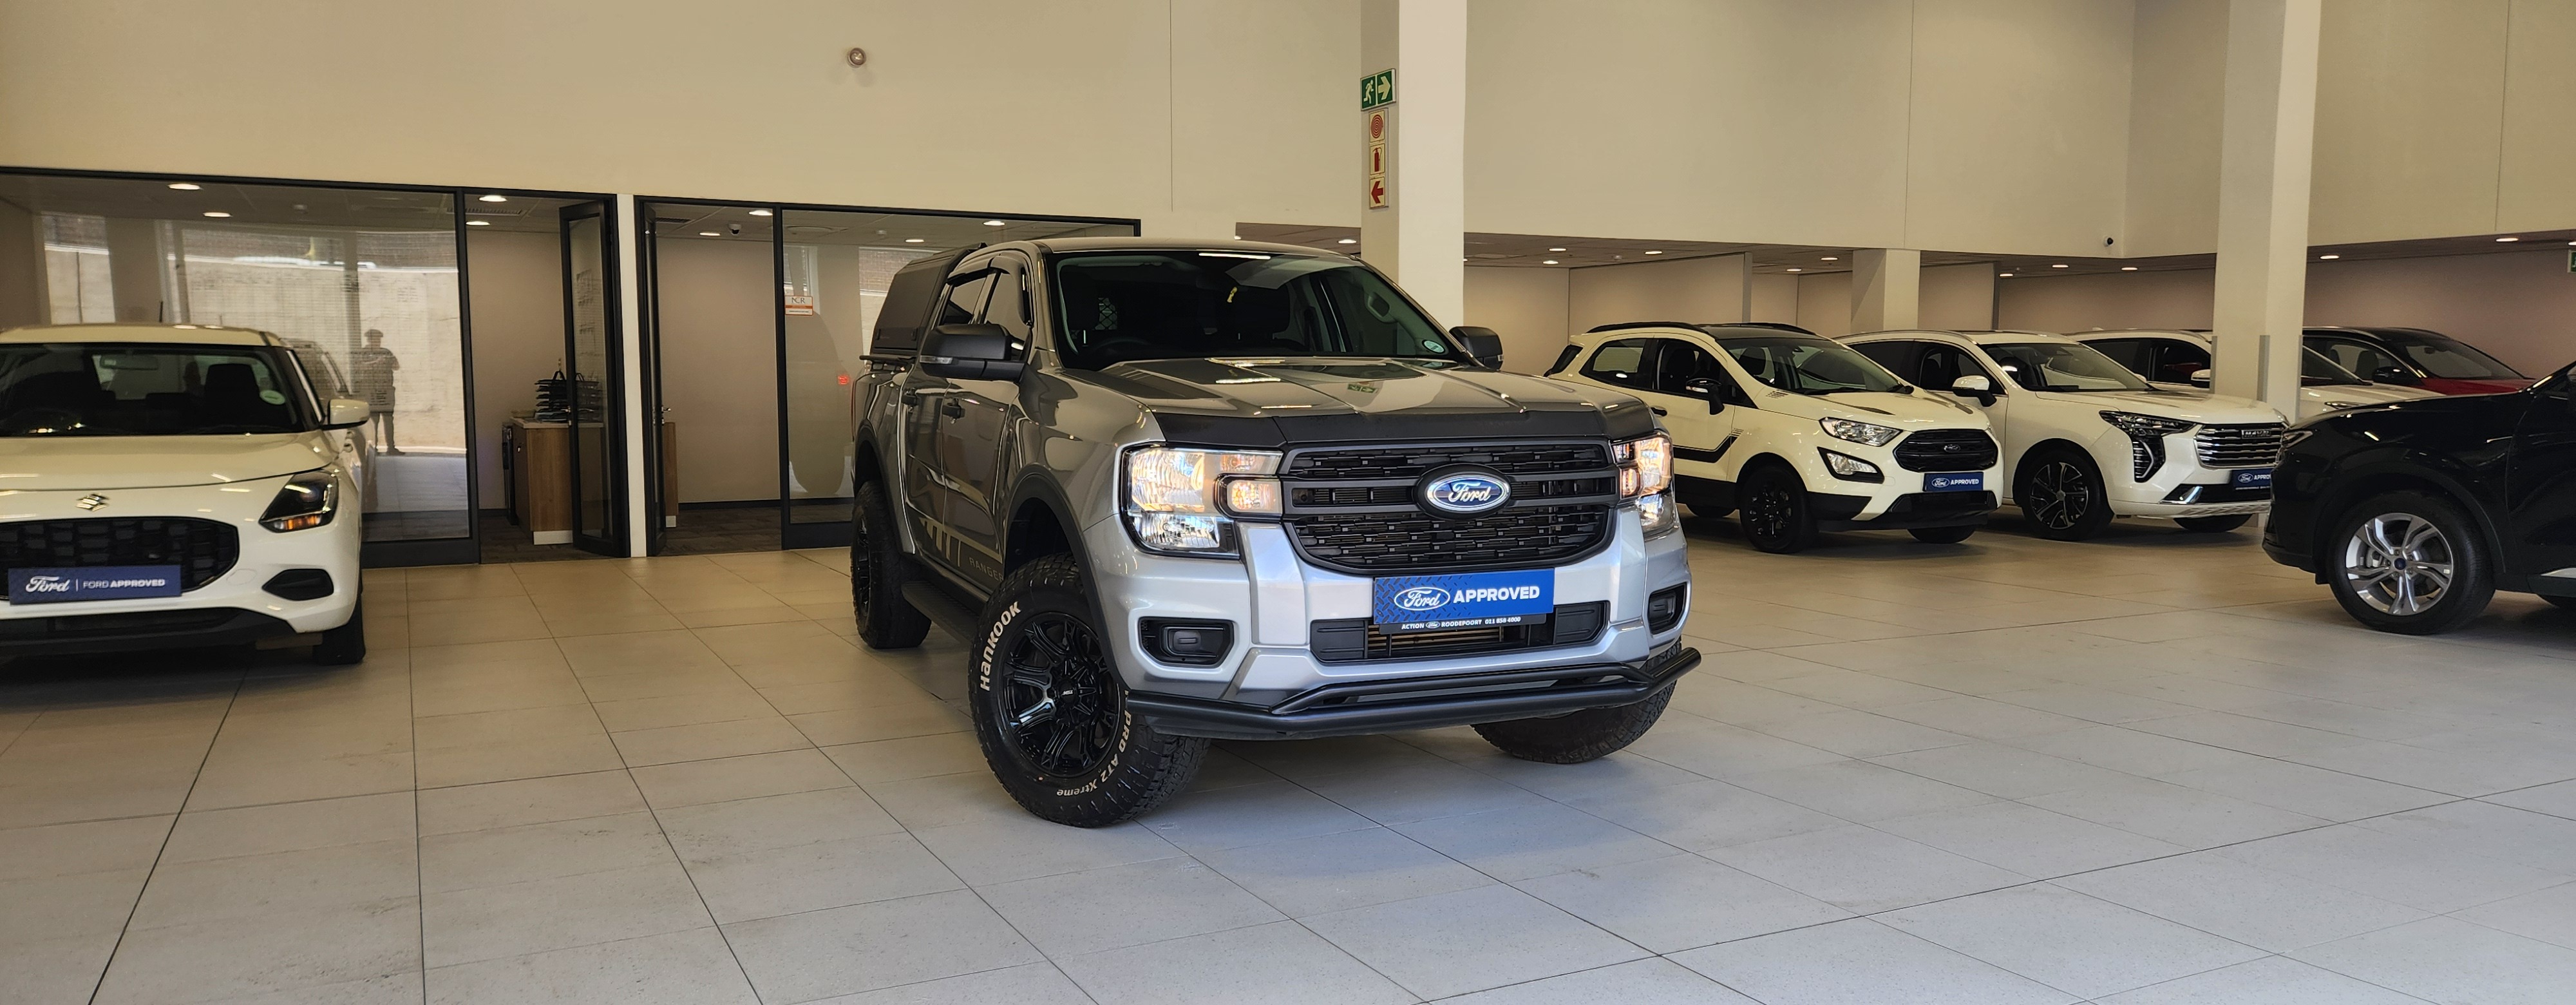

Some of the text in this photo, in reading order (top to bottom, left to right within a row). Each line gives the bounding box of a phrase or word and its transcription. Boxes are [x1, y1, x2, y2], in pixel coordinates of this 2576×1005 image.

[1934, 478, 1947, 486] Ford
[1448, 482, 1492, 503] Ford
[969, 557, 1004, 582] RANGER
[25, 575, 166, 593] Ford FORD APPROVED
[1404, 586, 1540, 608] Ford APPROVED
[1441, 619, 1482, 627] ROODEPOORT
[1056, 778, 1097, 796] Xtreme
